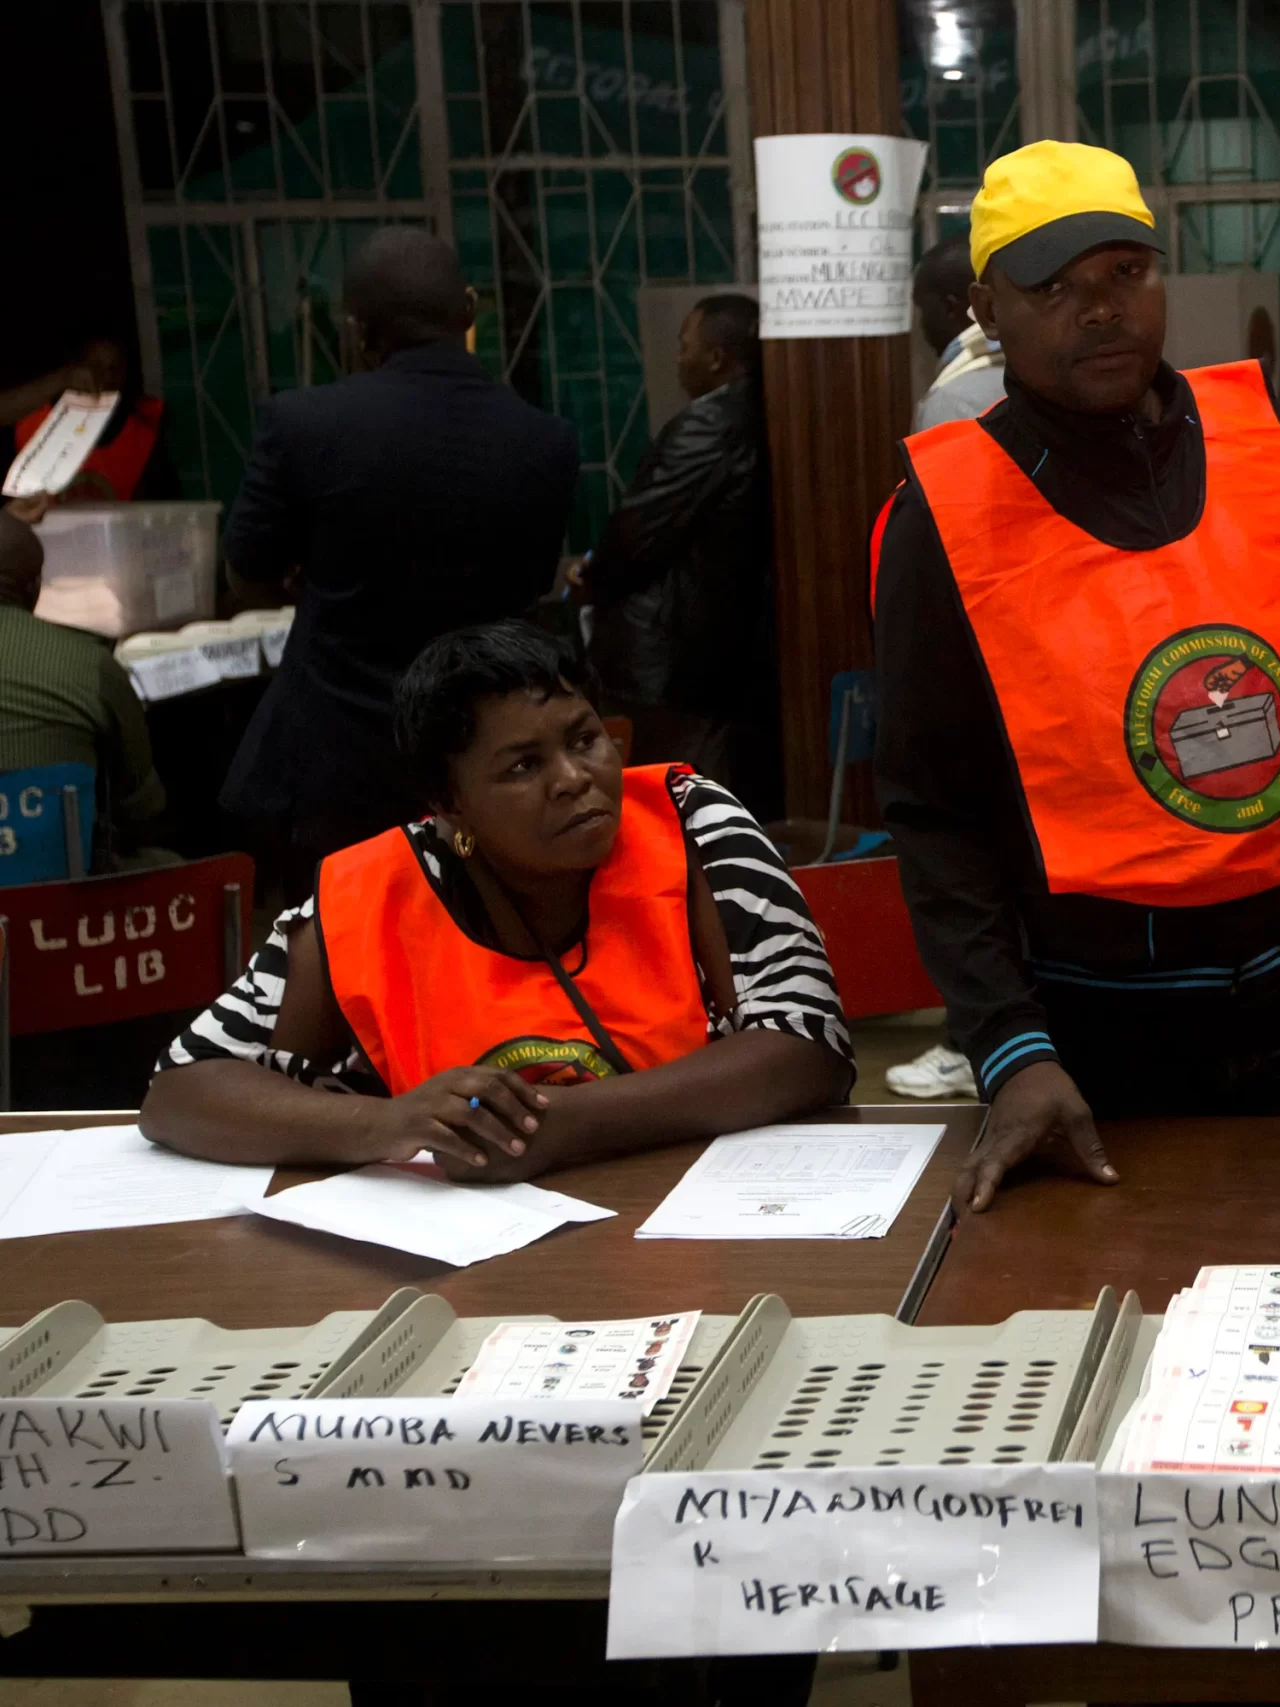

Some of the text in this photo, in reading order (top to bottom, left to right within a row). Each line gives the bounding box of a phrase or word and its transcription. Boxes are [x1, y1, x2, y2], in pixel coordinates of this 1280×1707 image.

[1163, 635, 1247, 667] COMMISSION
[1251, 645, 1268, 661] OF
[1169, 787, 1203, 814] Free
[1236, 799, 1264, 820] and
[74, 949, 165, 996] LIB
[497, 1046, 580, 1069] OMMISSION
[0, 1407, 171, 1452] AKWI
[249, 1411, 630, 1446] MUMBA NEVERS
[273, 1458, 299, 1487] S
[693, 1540, 720, 1568] K
[741, 1575, 947, 1615] HERITAGE
